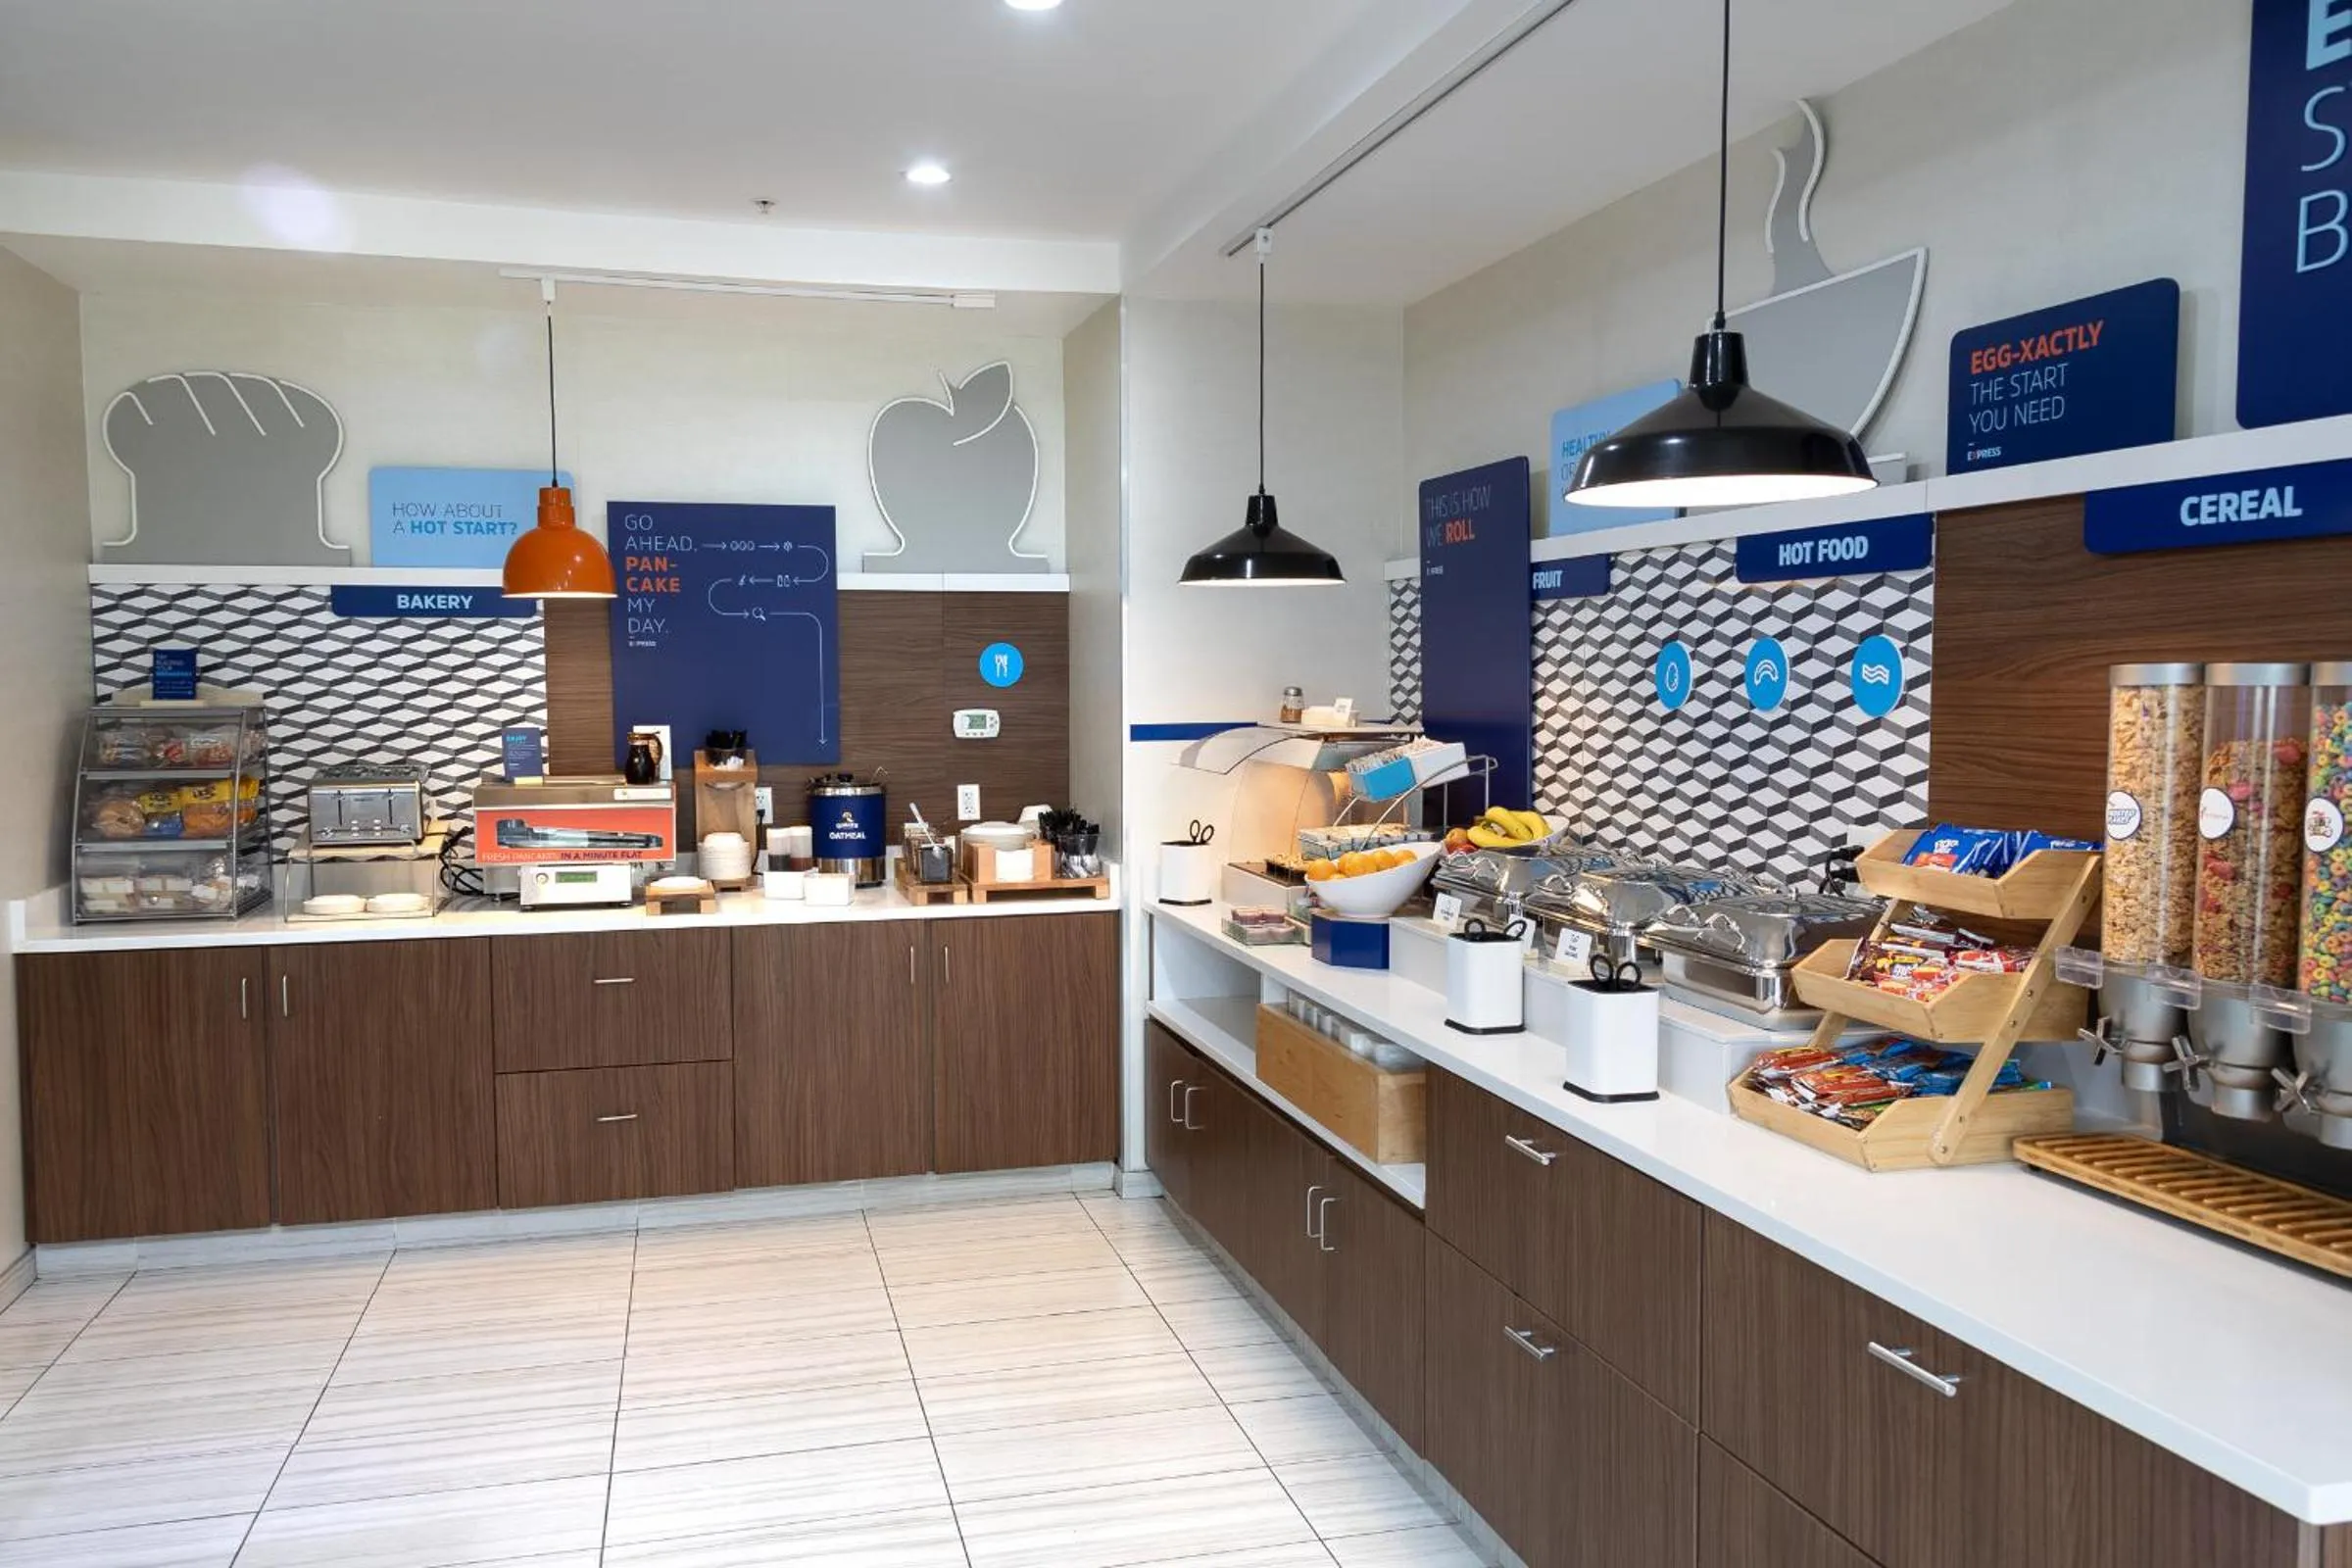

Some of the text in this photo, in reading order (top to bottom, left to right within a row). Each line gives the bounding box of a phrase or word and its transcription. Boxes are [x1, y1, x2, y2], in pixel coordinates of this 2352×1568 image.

[1971, 319, 2104, 374] EGG-XACTLY
[1970, 363, 2069, 406] THE START
[1969, 396, 2065, 434] YOU NEED
[392, 501, 503, 518] HOW ABOUT
[1425, 483, 1492, 520] THIS IS HOW
[2180, 485, 2303, 526] CEREAL
[392, 519, 518, 535] A HOT START?
[624, 514, 654, 531] GO
[1425, 518, 1476, 548] WE ROLL
[624, 535, 698, 552] AHEAD.
[1779, 534, 1870, 566] HOT FOOD
[625, 556, 678, 572] PAN-
[626, 576, 681, 593] CAKE
[1532, 568, 1564, 590] FRUIT
[396, 594, 473, 610] BAKERY
[626, 597, 656, 613] MY
[627, 616, 669, 634] DAY.
[560, 852, 571, 860] IN
[582, 850, 618, 859] MINUTE
[620, 850, 644, 859] FLAT
